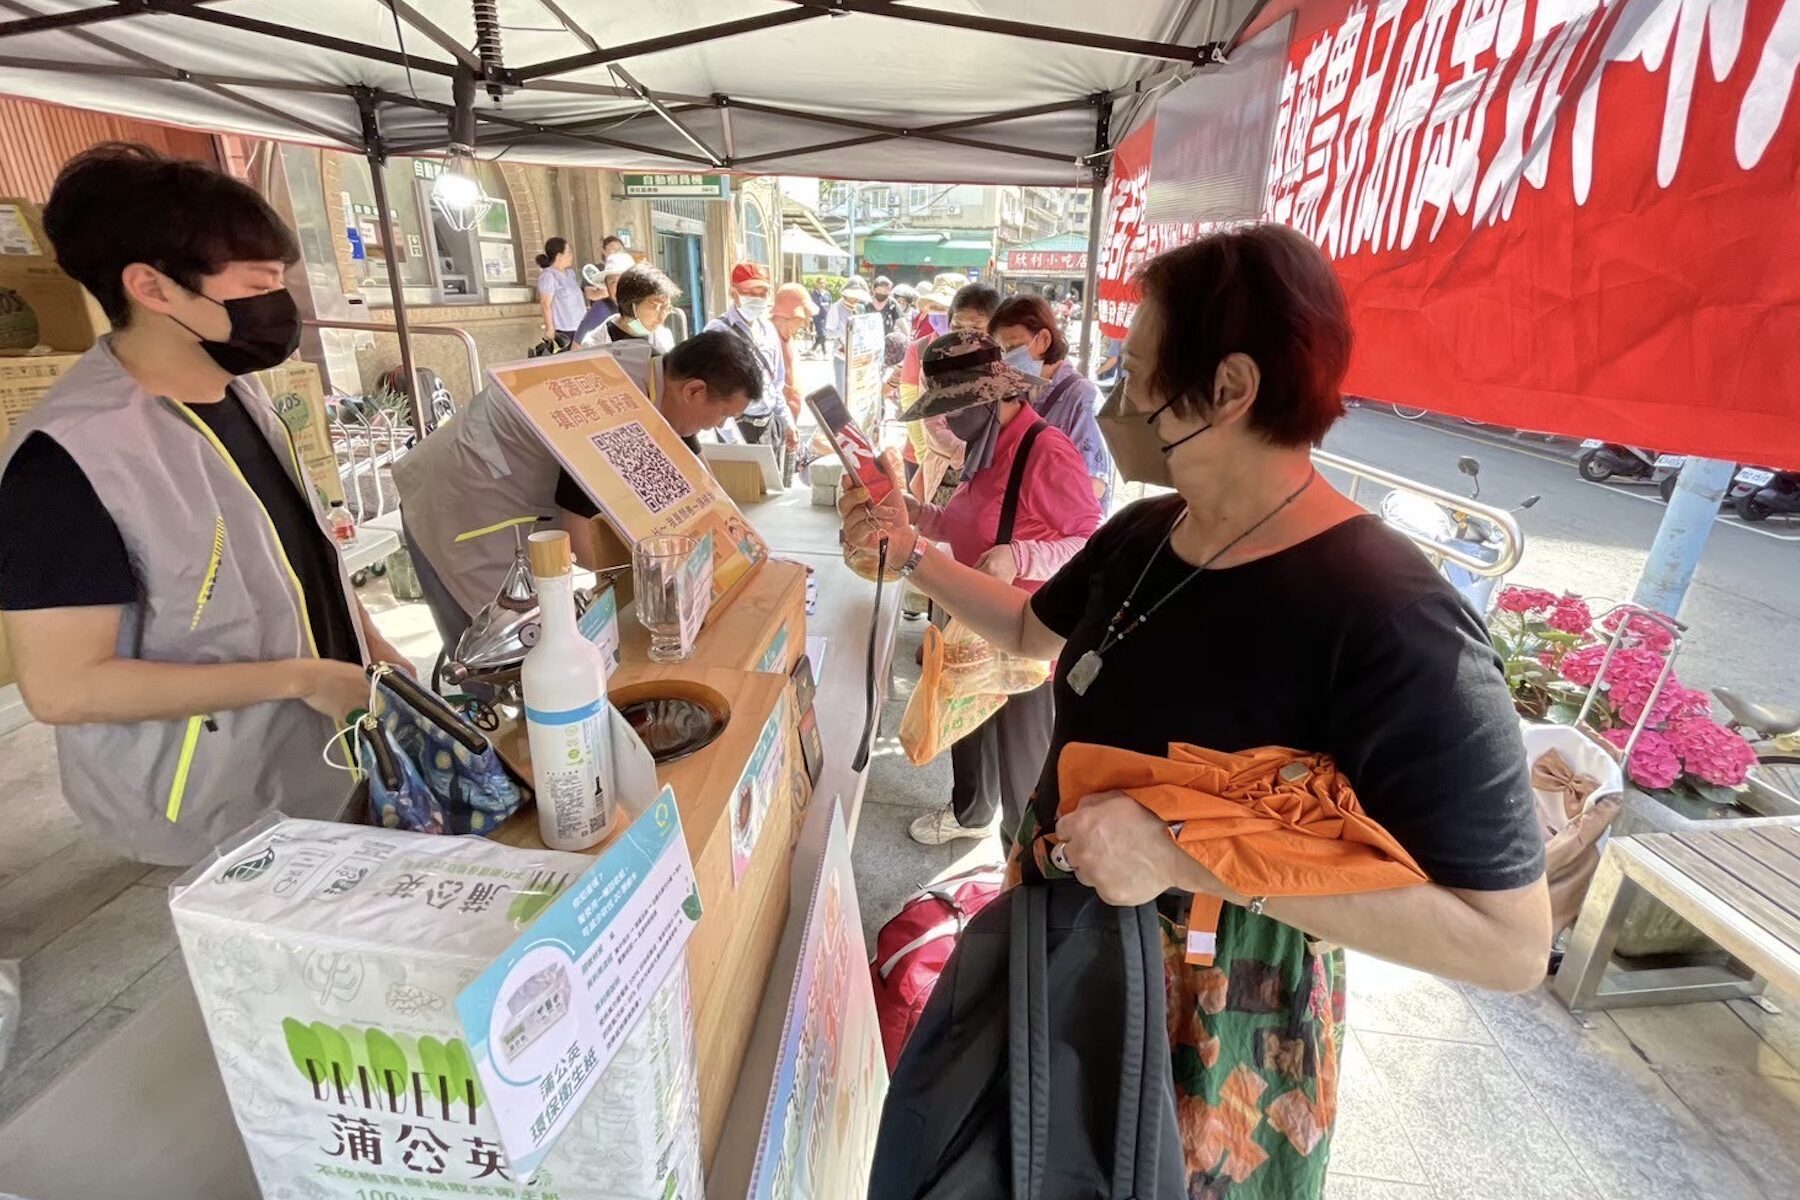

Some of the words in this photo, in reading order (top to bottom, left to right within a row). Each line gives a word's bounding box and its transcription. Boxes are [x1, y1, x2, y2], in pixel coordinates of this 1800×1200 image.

[547, 374, 608, 401] 資源回收
[550, 403, 601, 430] 填問卷
[305, 1058, 477, 1125] DANDELI
[529, 1045, 598, 1143] 環保衛生紙
[540, 1040, 582, 1102] 蒲公英
[319, 1113, 538, 1186] 蒲公英
